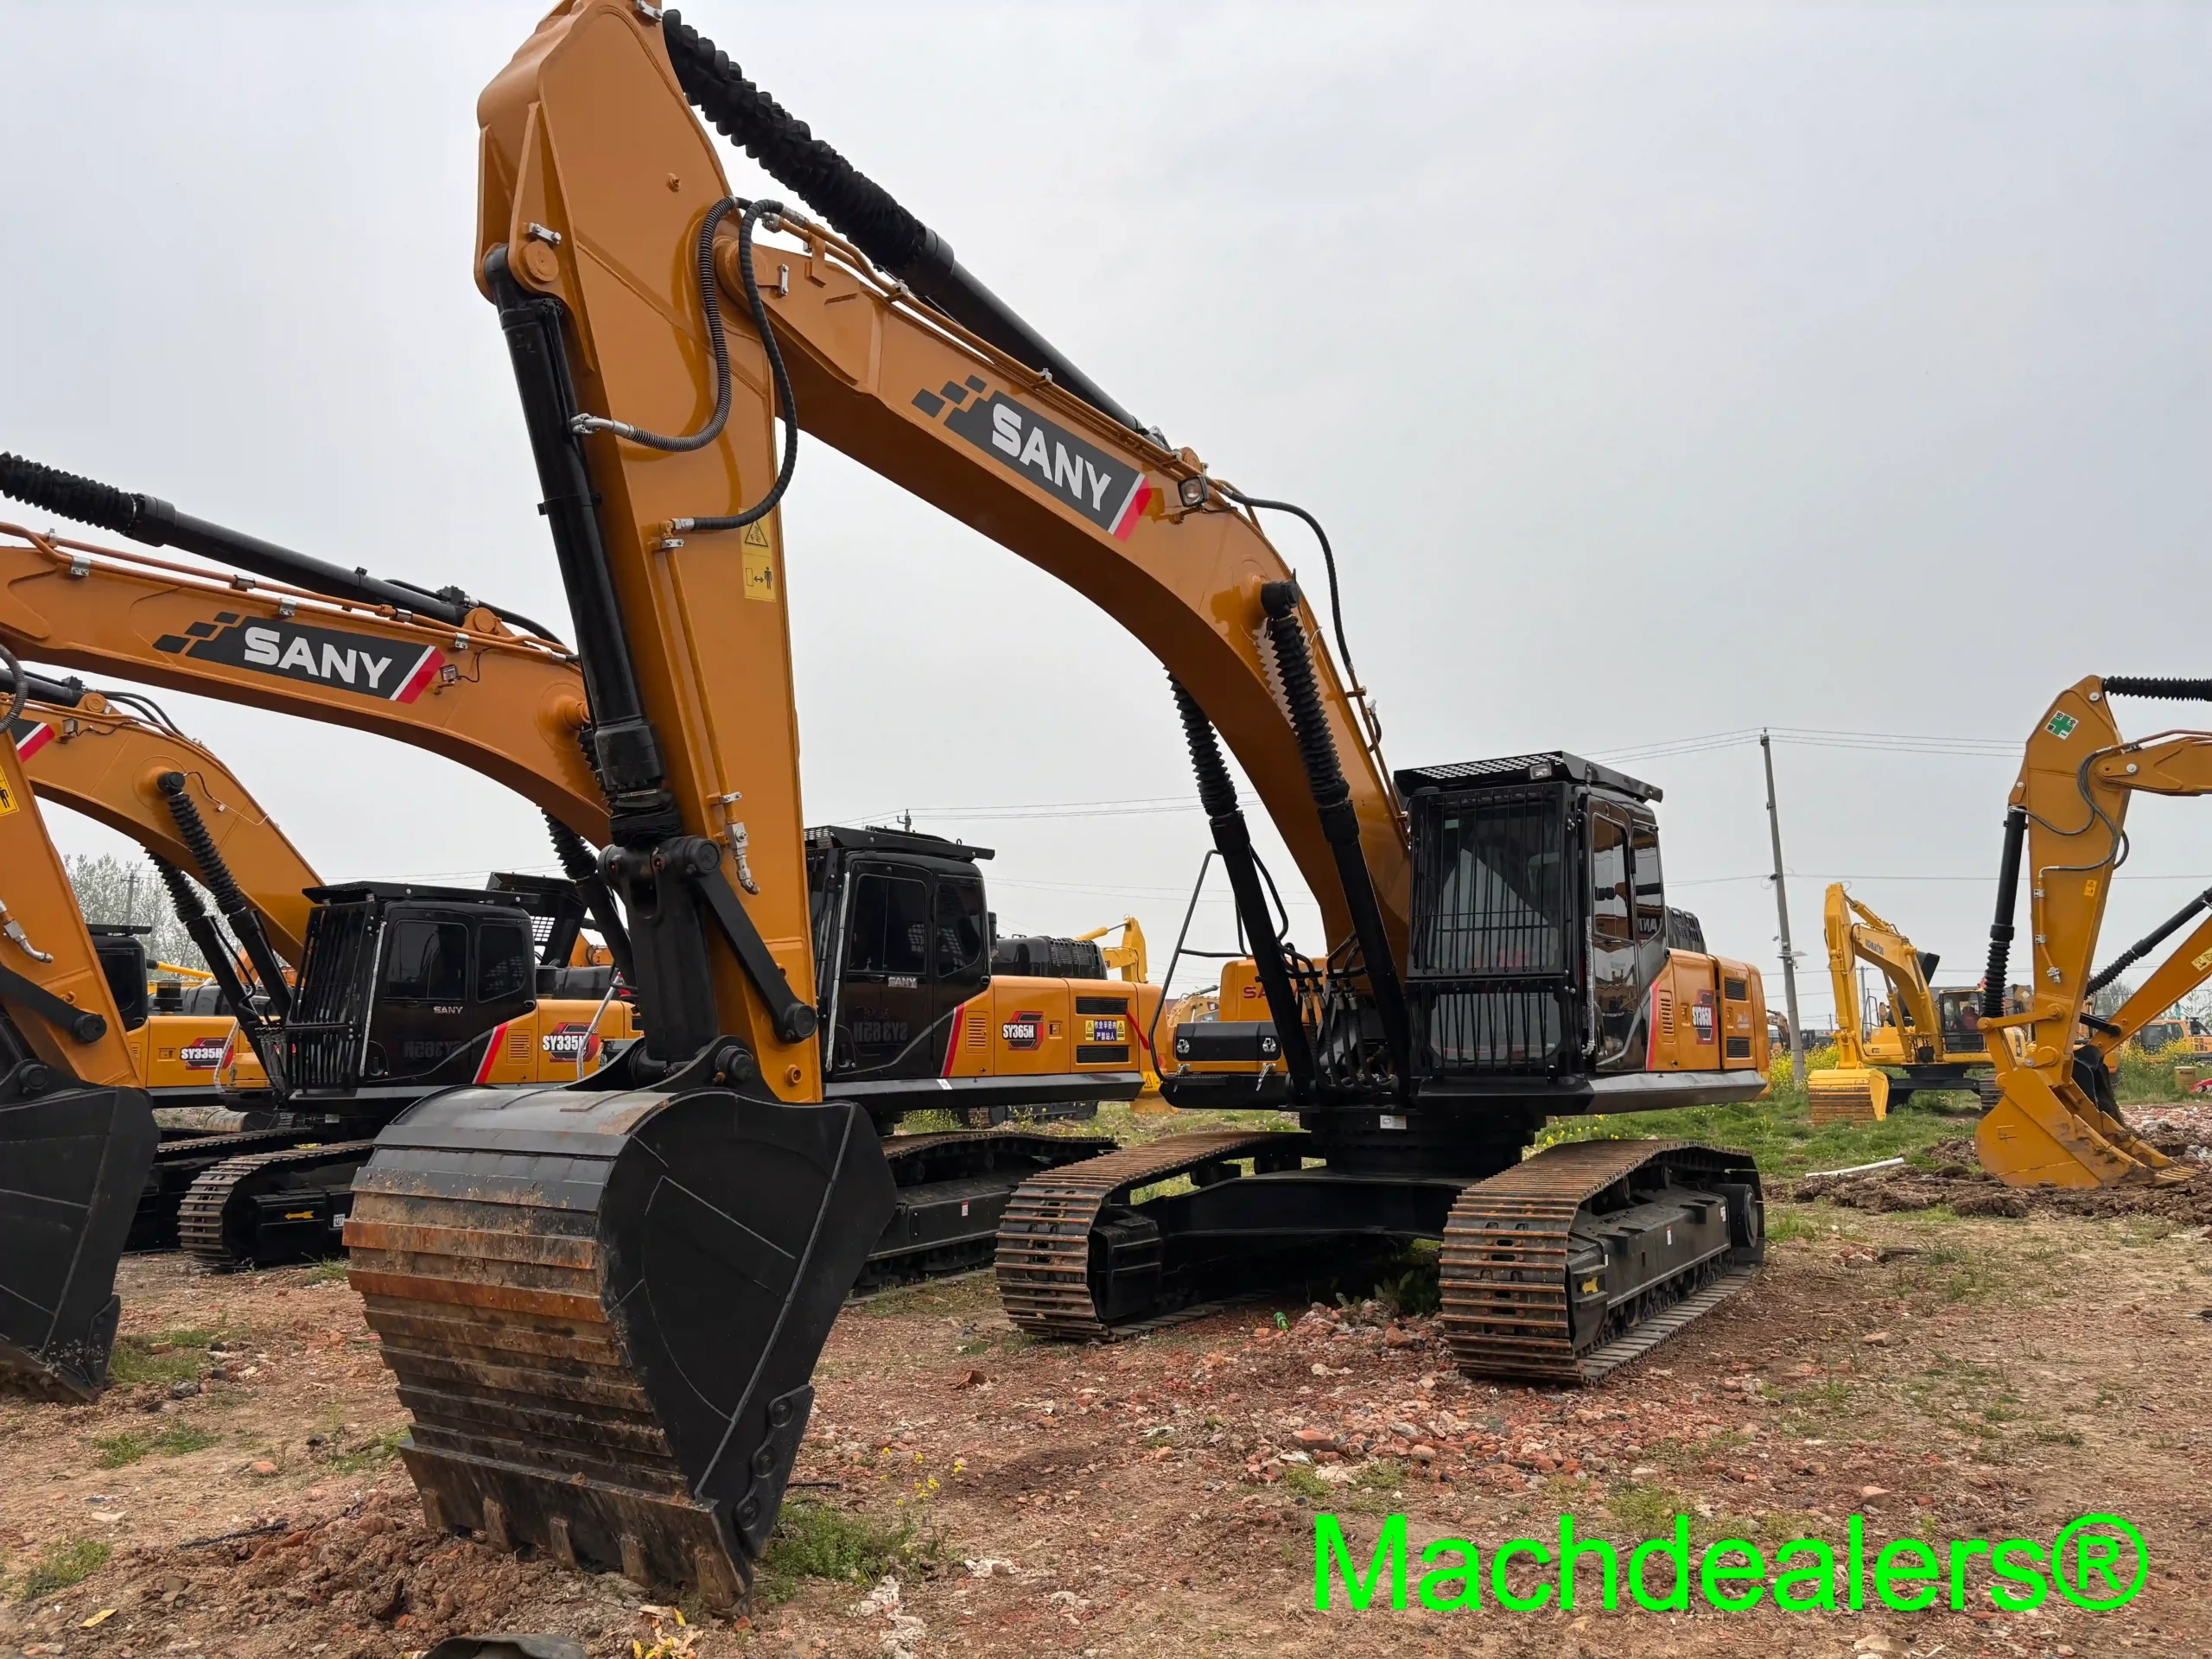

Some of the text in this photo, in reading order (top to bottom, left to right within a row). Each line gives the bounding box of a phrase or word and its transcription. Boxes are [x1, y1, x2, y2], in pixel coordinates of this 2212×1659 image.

[992, 403, 1112, 512] SANY
[244, 626, 392, 689] SANY
[433, 1006, 464, 1014] SANY
[1692, 1006, 1713, 1027] SY365H
[1002, 1024, 1034, 1039] SY365H
